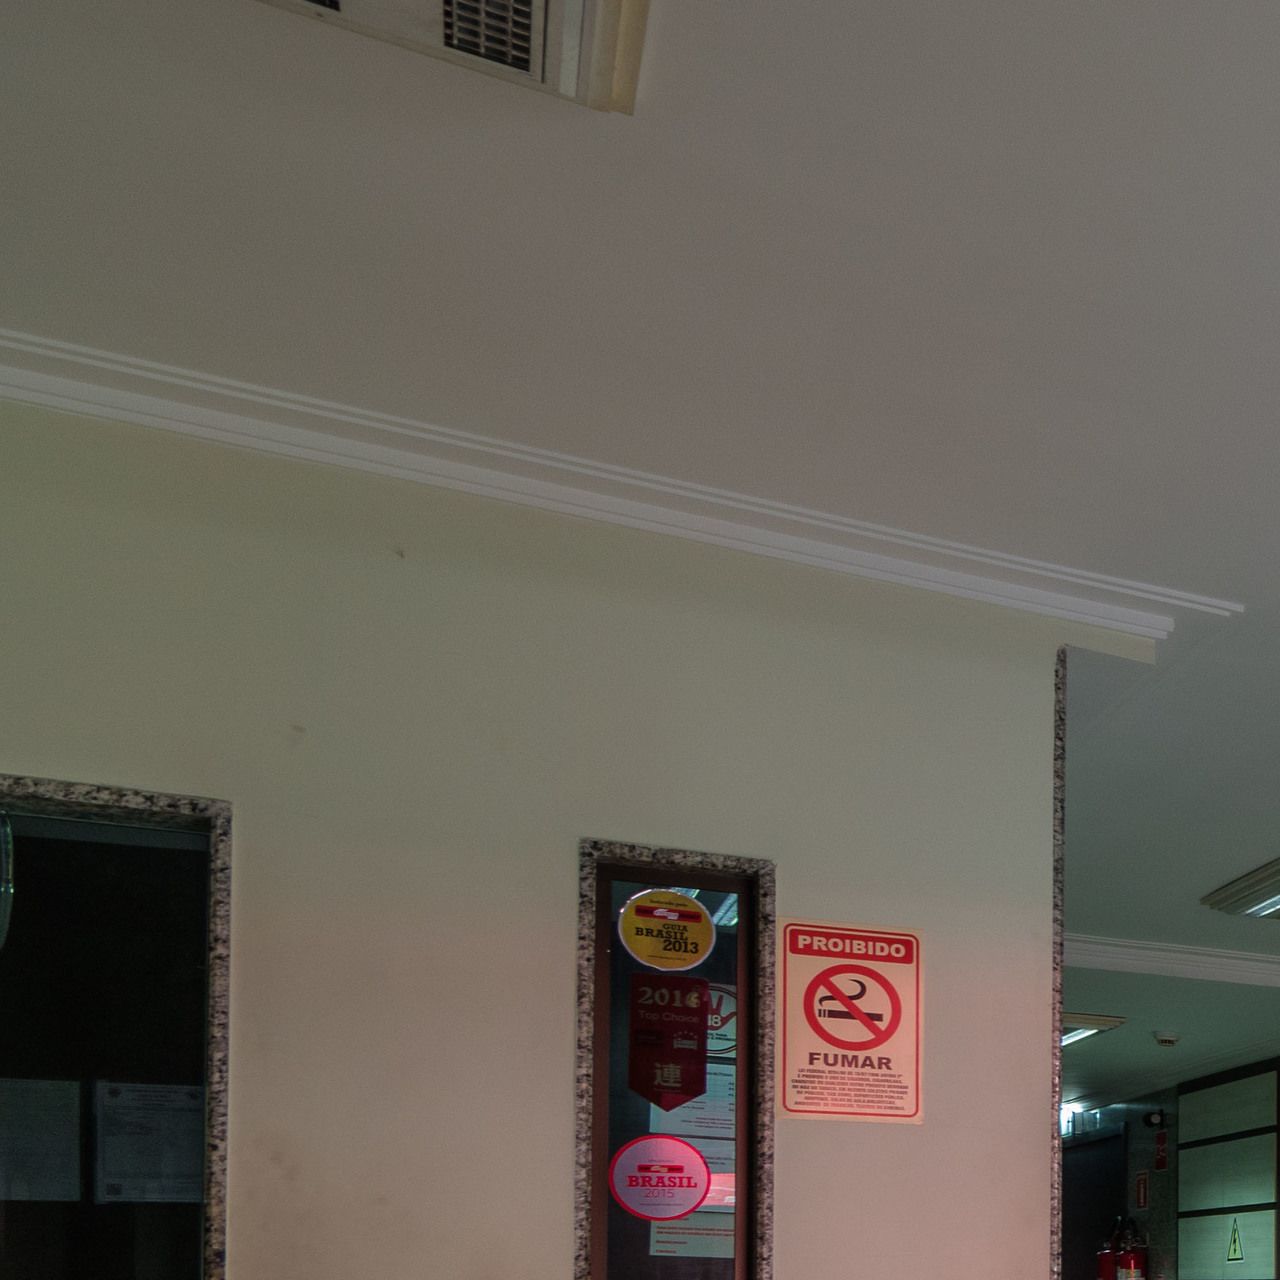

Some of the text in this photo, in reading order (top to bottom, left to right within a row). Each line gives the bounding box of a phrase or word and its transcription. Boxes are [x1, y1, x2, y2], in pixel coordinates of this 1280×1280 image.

[635, 926, 689, 941] BRASIL
[662, 923, 689, 933] GUIA
[663, 939, 699, 954] 2013
[797, 934, 906, 958] PROIBIDO
[637, 1009, 700, 1023] Top Choice
[808, 1051, 893, 1071] FUMAR
[626, 1175, 698, 1188] BRASIL
[645, 1188, 675, 1199] 2015
